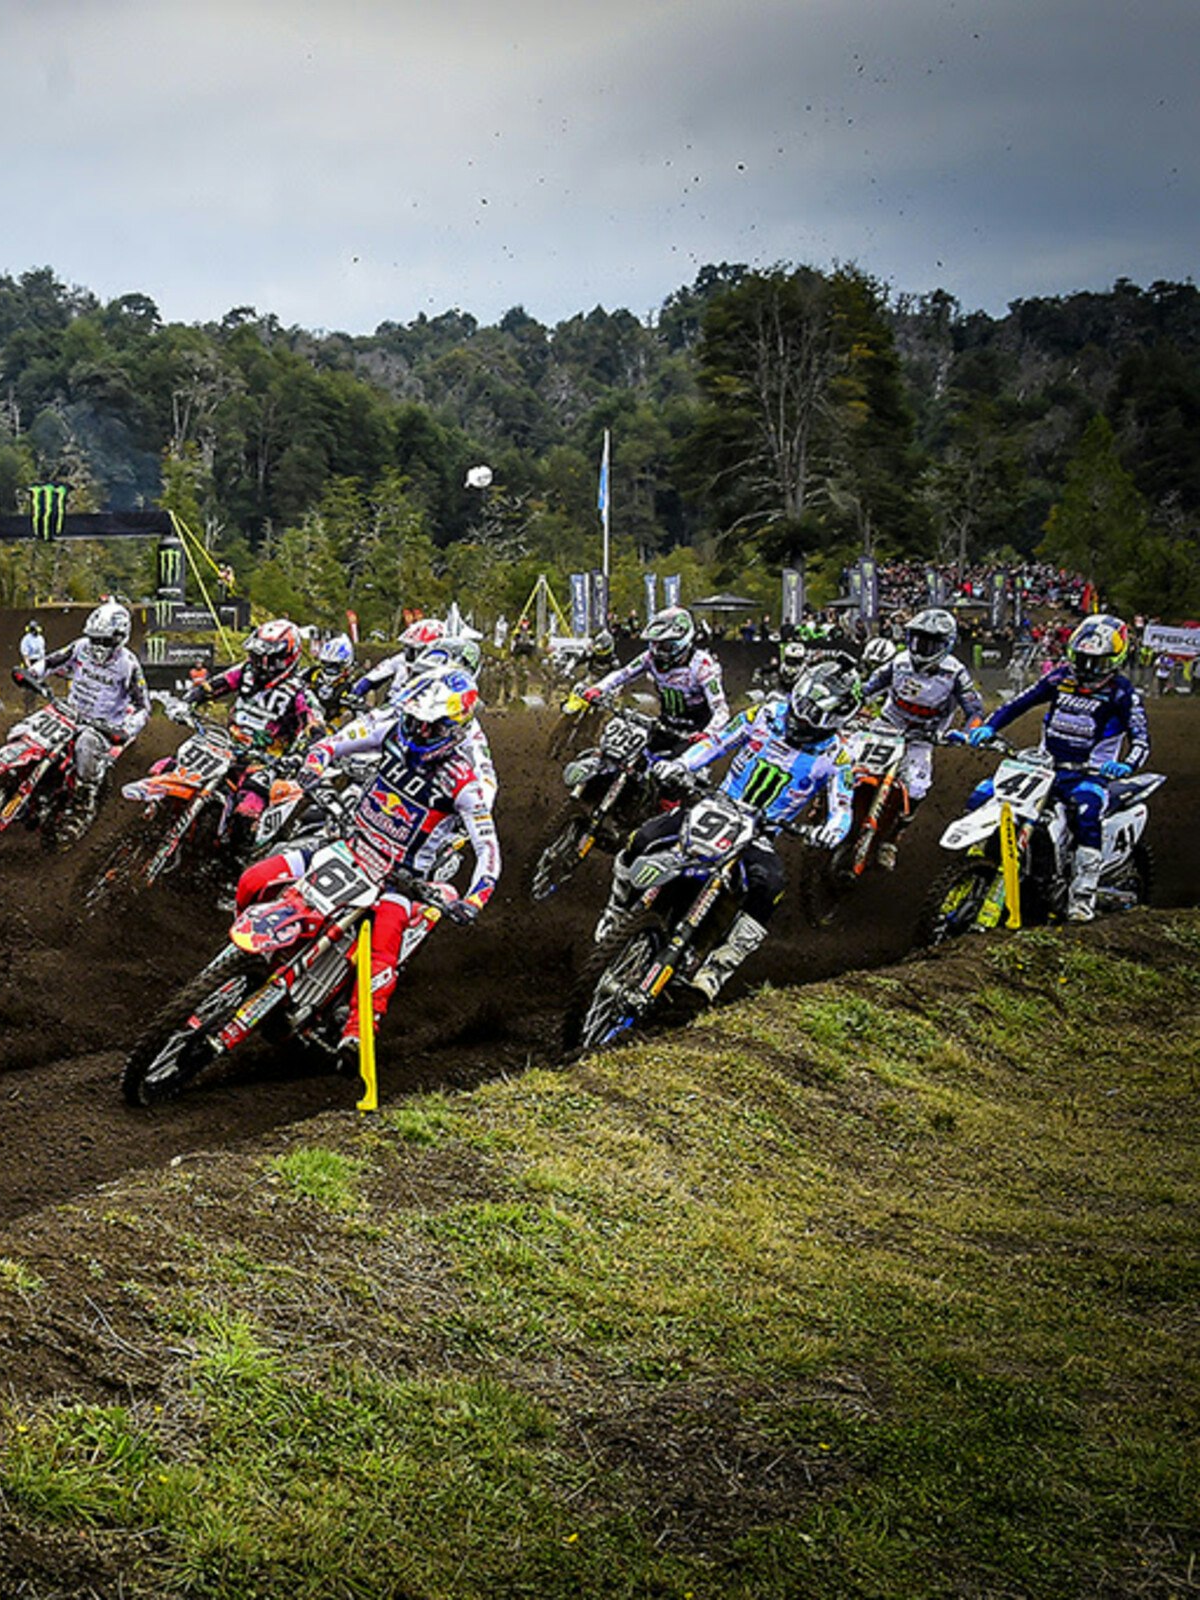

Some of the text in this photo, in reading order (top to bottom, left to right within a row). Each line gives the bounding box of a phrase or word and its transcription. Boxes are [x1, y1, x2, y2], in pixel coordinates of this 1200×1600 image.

[32, 712, 74, 745] 303
[609, 724, 646, 754] 259
[861, 743, 896, 765] 19
[996, 773, 1044, 800] 41
[691, 810, 746, 849] 91
[305, 856, 372, 907] 61
